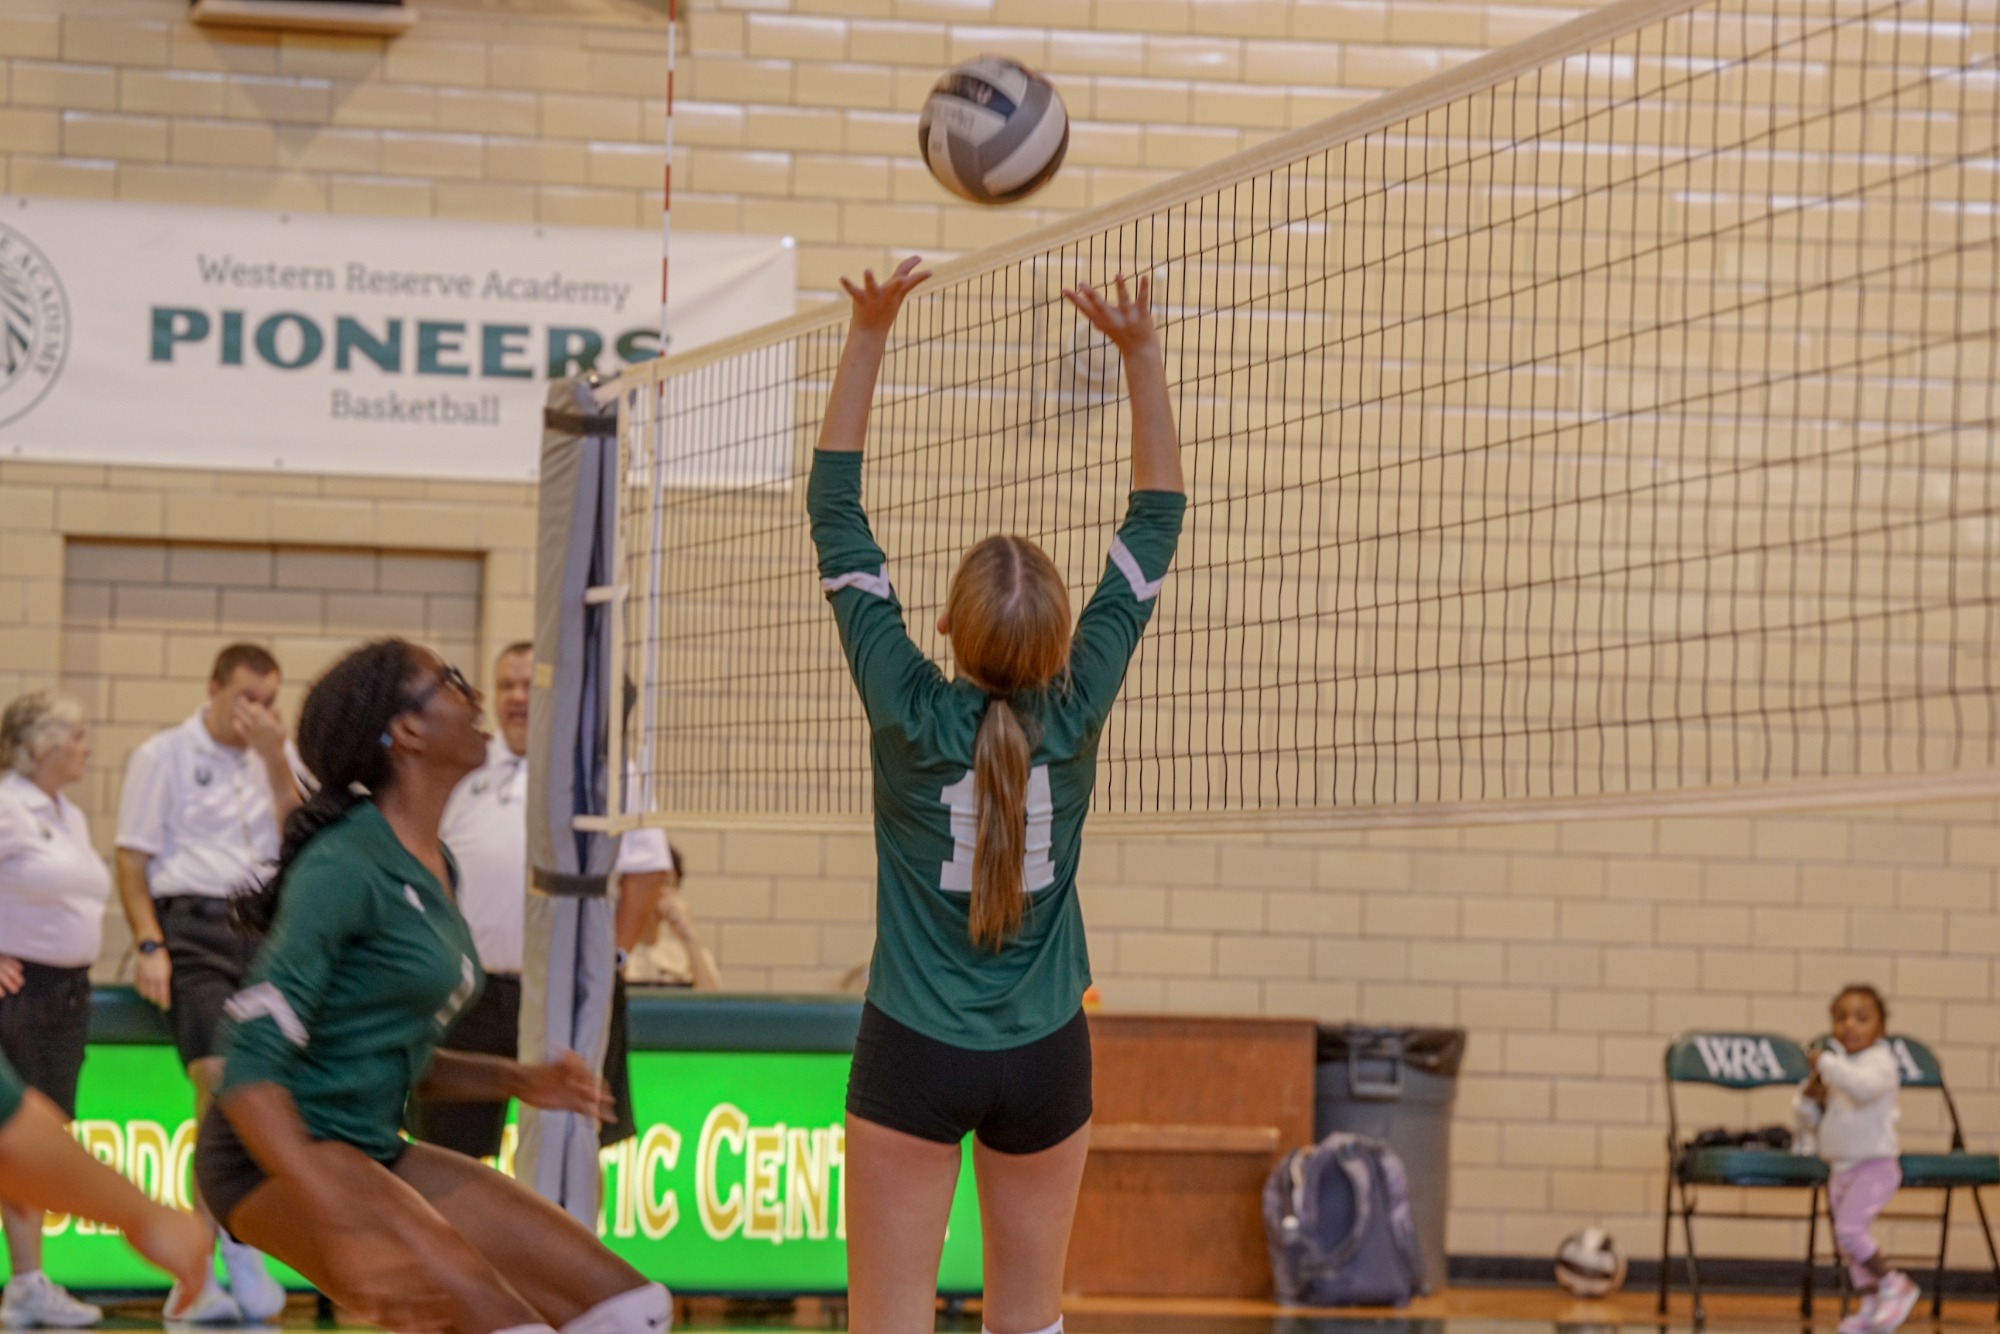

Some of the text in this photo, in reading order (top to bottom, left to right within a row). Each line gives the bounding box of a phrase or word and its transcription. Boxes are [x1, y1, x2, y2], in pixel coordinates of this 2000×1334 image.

[197, 254, 632, 312] Western Reserve Academy
[148, 306, 670, 381] PIONEERS
[330, 389, 500, 425] Basketball
[1694, 1035, 1786, 1080] WRA
